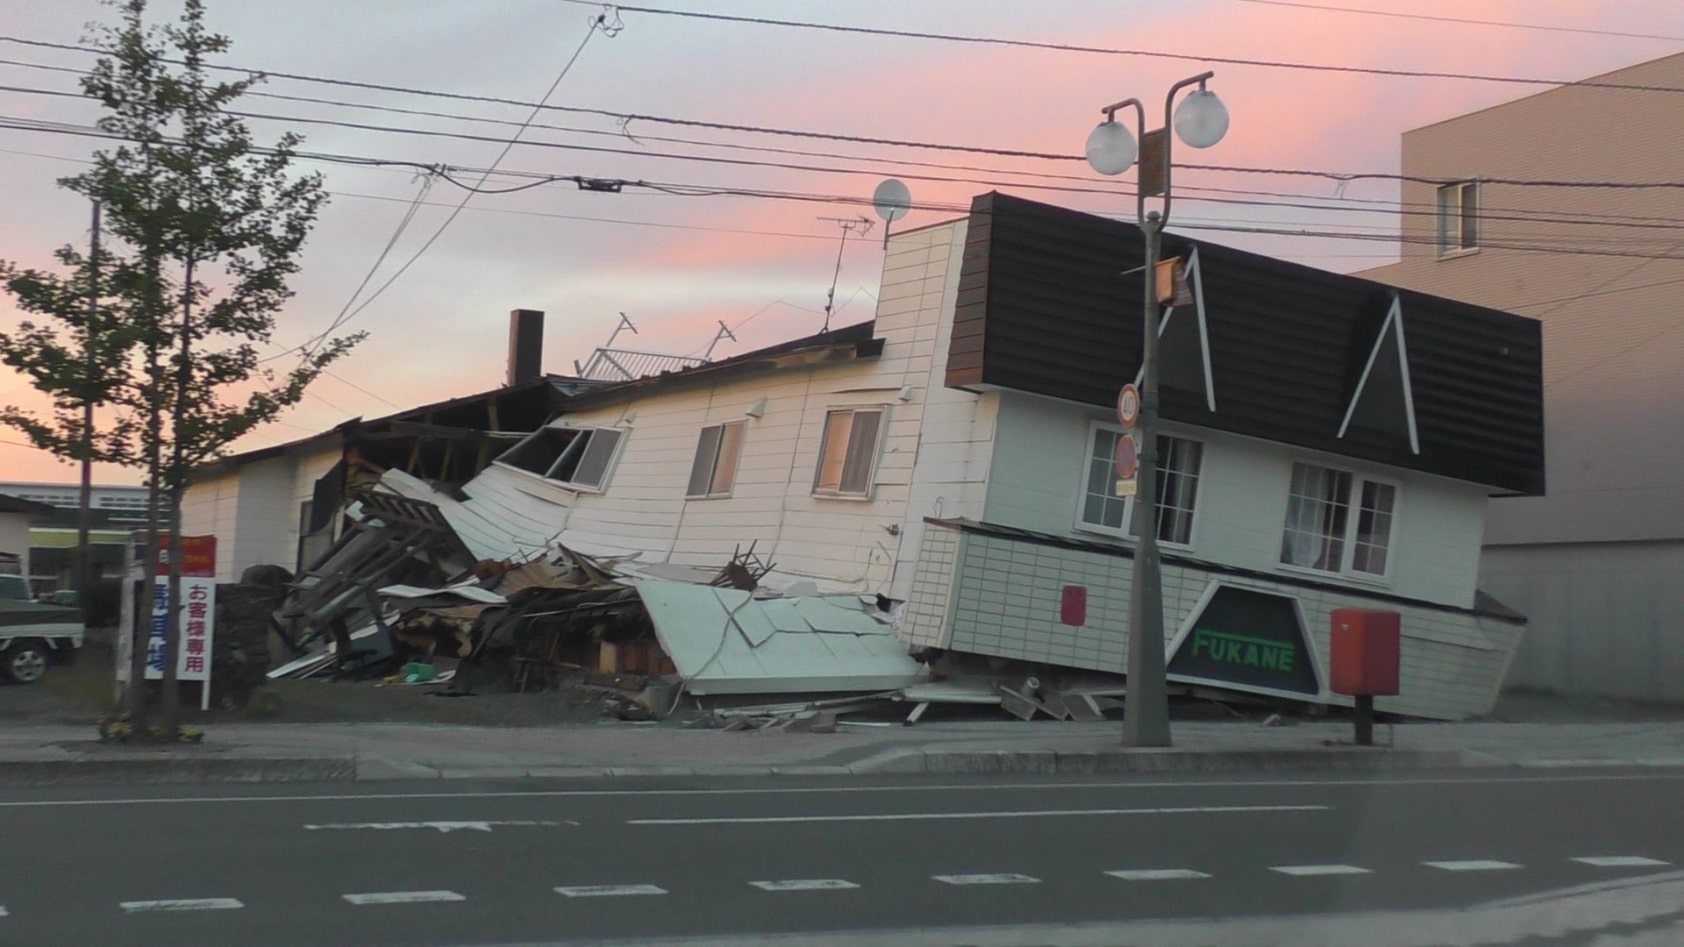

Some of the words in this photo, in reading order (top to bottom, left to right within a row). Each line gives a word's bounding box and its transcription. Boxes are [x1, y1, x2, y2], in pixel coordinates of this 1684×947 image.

[185, 584, 208, 672] お客様専用
[1192, 629, 1295, 672] FUKANE
